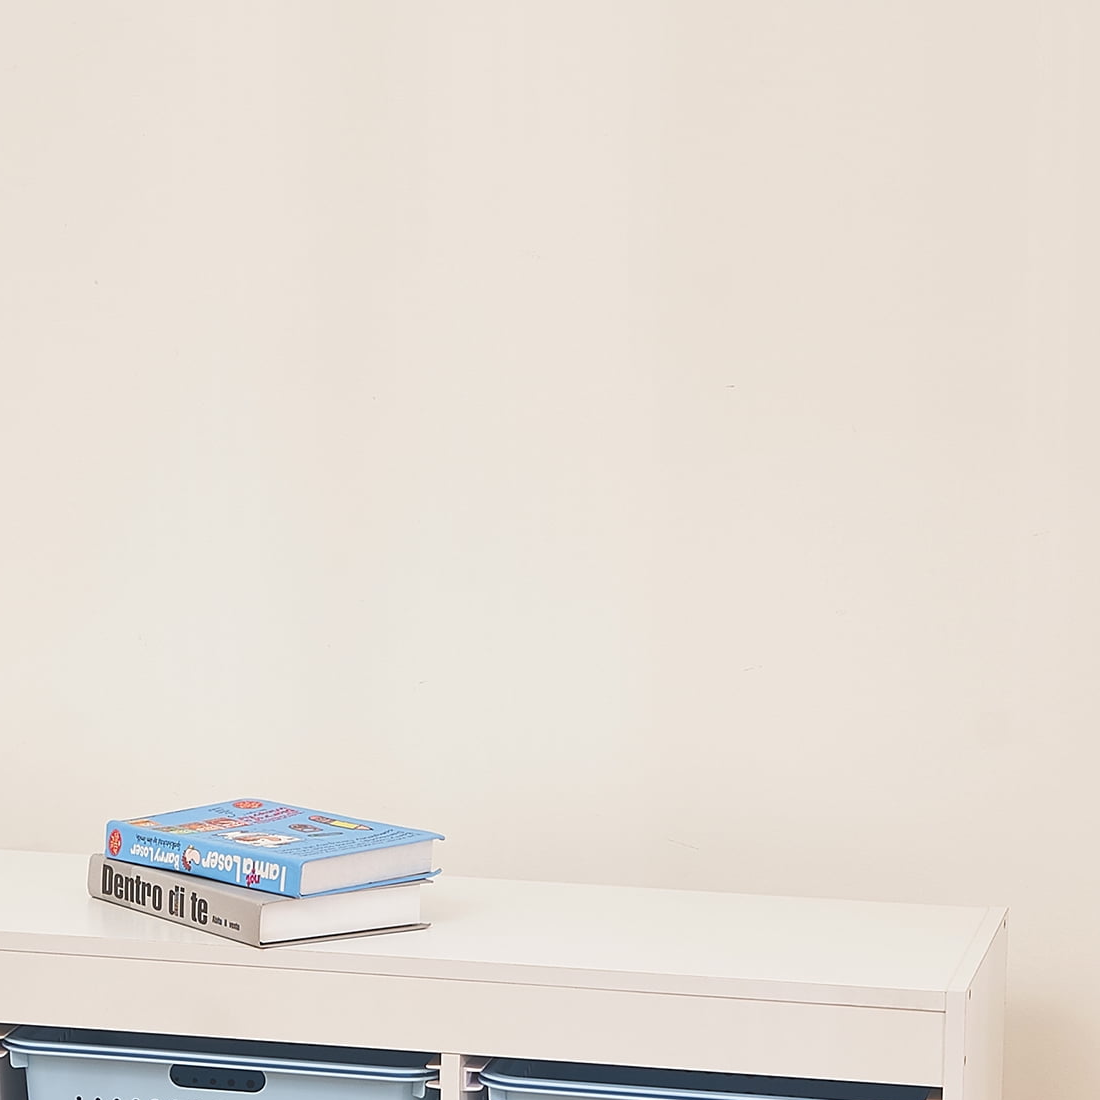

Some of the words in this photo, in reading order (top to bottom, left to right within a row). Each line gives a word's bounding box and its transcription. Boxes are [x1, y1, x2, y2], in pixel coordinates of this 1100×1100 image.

[130, 843, 154, 863] Loser
[153, 847, 180, 871] Barry
[201, 851, 241, 883] Loser
[242, 857, 254, 875] a
[255, 860, 280, 881] am
[245, 874, 261, 888] not
[280, 866, 287, 892] I
[101, 863, 163, 911] Dentro
[168, 885, 185, 918] di
[190, 891, 208, 925] te
